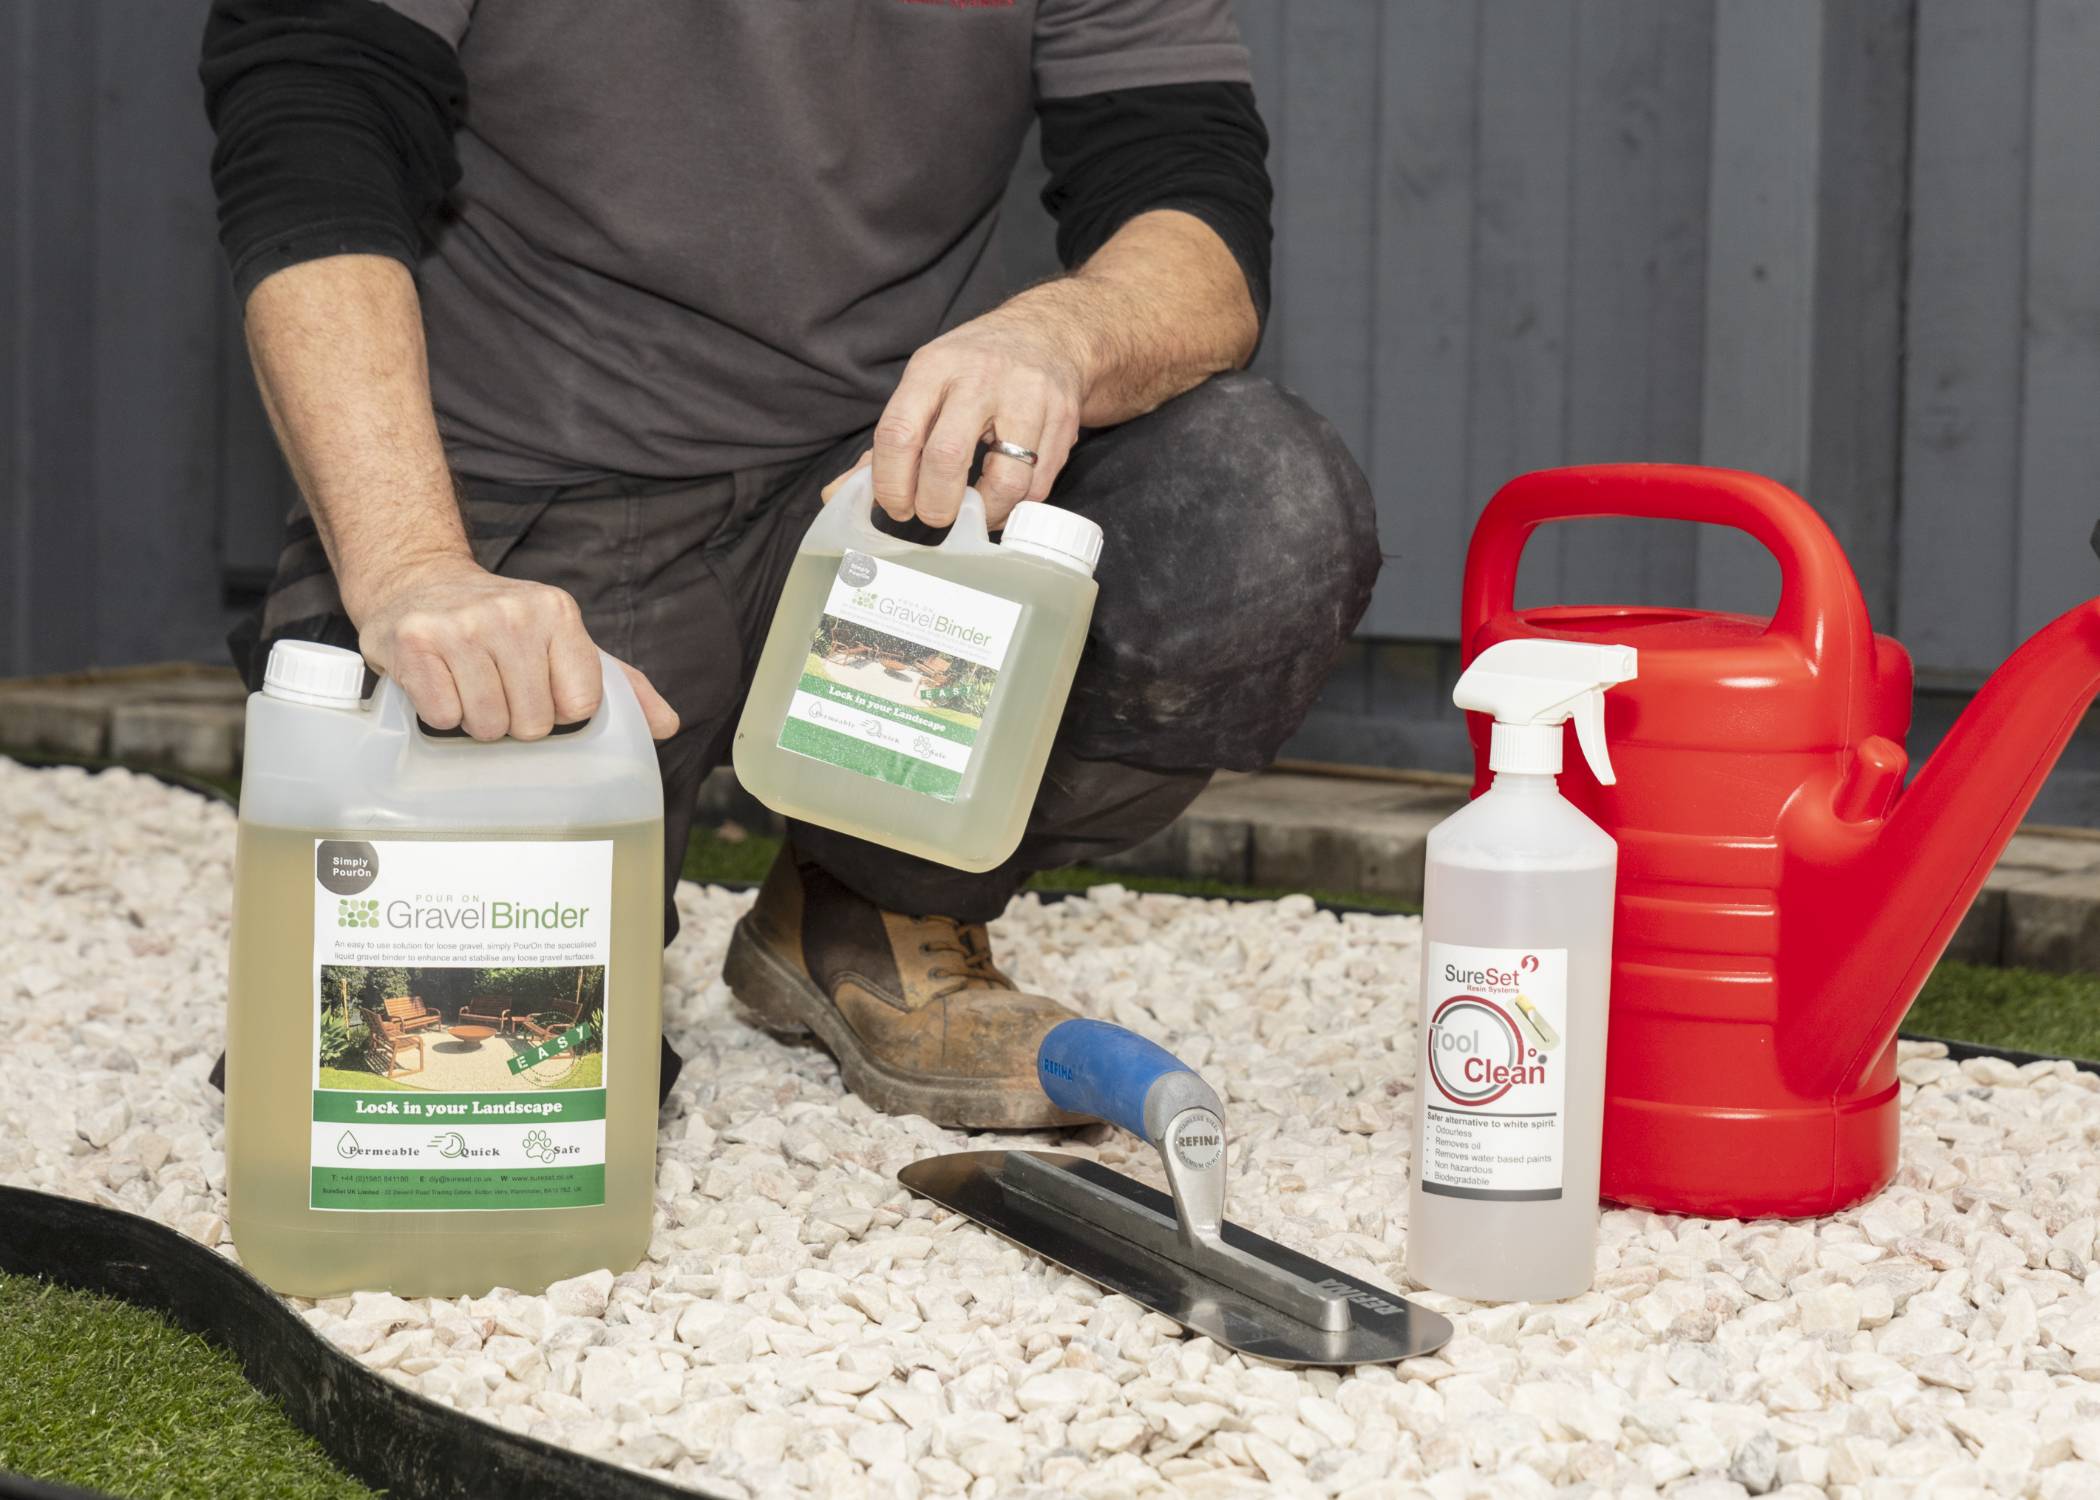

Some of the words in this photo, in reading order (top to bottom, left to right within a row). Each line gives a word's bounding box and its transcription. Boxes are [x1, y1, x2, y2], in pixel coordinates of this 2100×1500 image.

[879, 597, 934, 628] Gravel
[934, 615, 992, 648] Binder
[926, 686, 972, 699] EASY
[829, 685, 853, 702] Lock
[855, 694, 866, 706] in
[867, 698, 893, 715] your
[894, 705, 946, 733] Landscape
[333, 856, 368, 869] Simply
[333, 868, 372, 878] PourOn
[415, 894, 454, 903] POUR
[462, 895, 481, 903] ON
[335, 940, 345, 948] An
[347, 942, 365, 950] easy
[367, 941, 374, 949] to
[392, 941, 422, 949] solution
[424, 941, 434, 949] for
[436, 941, 457, 950] loose
[487, 942, 511, 951] simply
[544, 941, 555, 949] the
[558, 940, 597, 950] specialised
[335, 953, 354, 962] liquid
[357, 953, 379, 962] gravel
[382, 953, 405, 961] binder
[502, 955, 515, 963] any
[540, 953, 562, 962] gravel
[1445, 964, 1520, 986] SureSet
[1467, 985, 1486, 993] Resin
[1488, 986, 1520, 994] Systems
[1431, 1024, 1479, 1054] Tool
[516, 1025, 584, 1069] EASY
[1043, 1058, 1073, 1082] REFINA
[1464, 1057, 1545, 1085] Clean
[355, 1099, 399, 1115] Lock
[403, 1100, 422, 1115] in
[425, 1101, 468, 1118] your
[472, 1100, 563, 1117] Landscape
[1427, 1111, 1443, 1123] Safer
[1445, 1115, 1488, 1128] alternative
[1491, 1120, 1501, 1128] to
[1503, 1120, 1529, 1128] white
[1531, 1120, 1556, 1130] spirit.
[1435, 1125, 1473, 1138] Odourless
[1178, 1135, 1220, 1147] REFINA
[1435, 1137, 1469, 1150] Removes
[1471, 1142, 1481, 1150] oil
[349, 1145, 420, 1157] Permeable
[460, 1146, 501, 1159] Quick
[553, 1144, 581, 1155] Safe
[1435, 1149, 1469, 1161] Removes
[1471, 1155, 1495, 1163] water
[1497, 1155, 1524, 1163] based
[1526, 1154, 1552, 1164] paints
[1434, 1160, 1449, 1169] Non
[1450, 1162, 1493, 1174] hazardous
[1434, 1171, 1490, 1186] Biodegradable
